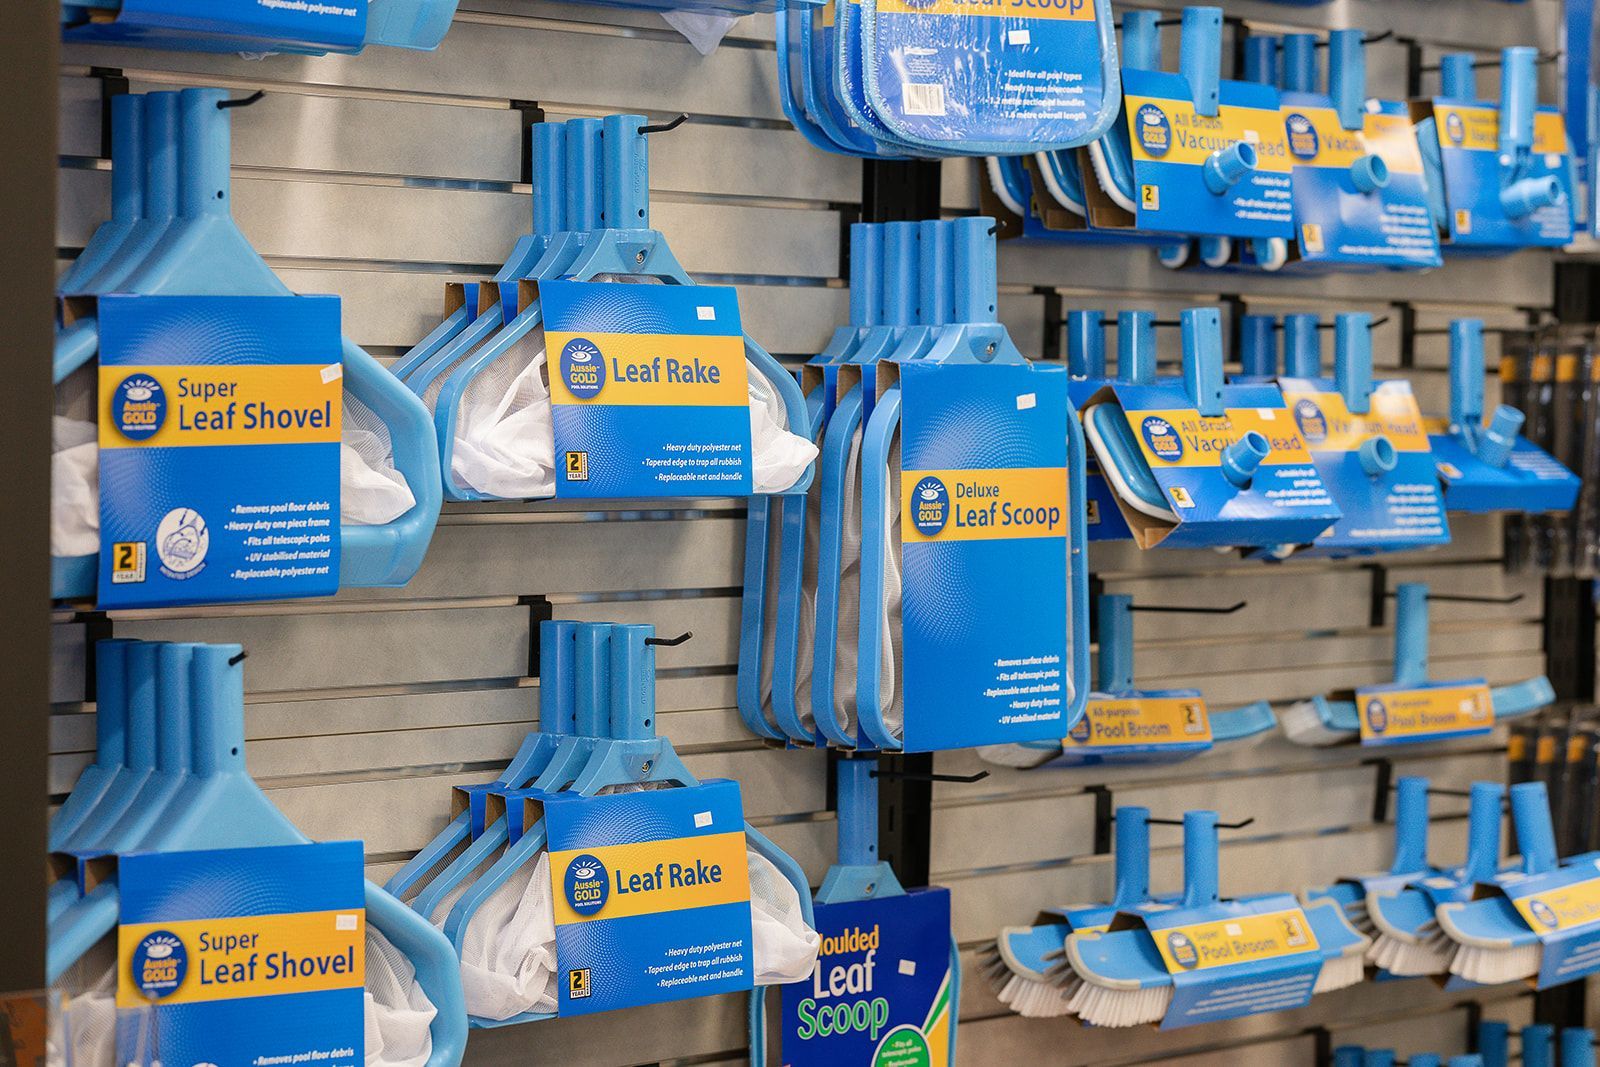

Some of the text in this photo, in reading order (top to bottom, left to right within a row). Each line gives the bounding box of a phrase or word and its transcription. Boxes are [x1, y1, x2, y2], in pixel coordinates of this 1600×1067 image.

[307, 3, 343, 14] polyester
[343, 8, 357, 16] net
[1011, 0, 1084, 15] oop
[1008, 70, 1026, 78] Ideal
[1027, 70, 1036, 79] for
[1037, 71, 1047, 79] all
[1063, 72, 1082, 82] types
[1004, 83, 1025, 93] Ready
[1037, 111, 1063, 119] overall
[1063, 112, 1087, 121] length
[1145, 187, 1152, 201] 2
[570, 363, 597, 373] Aussie
[612, 357, 720, 384] Leaf Rake
[570, 373, 598, 384] GOLD
[178, 378, 237, 401] Super
[122, 411, 157, 424] GOLD
[179, 401, 331, 430] Leaf Shovel
[666, 443, 687, 453] Heavy
[687, 443, 702, 453] duty
[702, 443, 731, 453] polyester
[570, 454, 579, 470] 2
[645, 458, 671, 468] Tapered
[672, 459, 687, 468] edge
[696, 460, 710, 468] trap
[710, 458, 718, 466] all
[719, 458, 742, 466] rubbish
[658, 473, 696, 483] Replaceable
[721, 472, 742, 480] handle
[956, 483, 1000, 498] Deluxe
[236, 501, 330, 515] Removes pool floor debris
[918, 510, 942, 521] GOLD
[955, 502, 1060, 530] Leaf Scoop
[229, 517, 330, 532] Heavy duty one piece frame
[248, 533, 330, 546] Fits all telescopic poles
[120, 546, 132, 568] 2
[249, 549, 331, 562] UV stabilised material
[235, 566, 329, 580] Replaceable polyester net
[1042, 654, 1059, 664] debris
[1000, 672, 1009, 681] Fits
[1010, 671, 1018, 680] all
[1029, 684, 1041, 693] and
[1041, 682, 1060, 692] handle
[1012, 697, 1060, 710] Heavy duty frame
[1037, 711, 1061, 720] material
[1095, 723, 1123, 737] Pool
[1128, 722, 1170, 737] Broom
[615, 859, 722, 895] Leaf Rake
[574, 880, 600, 890] Aussie
[574, 889, 601, 901] GOLD
[199, 931, 258, 955] Super
[668, 940, 743, 957] Heavy duty polyester net
[200, 946, 354, 985] Leaf Shovel
[648, 963, 673, 975] Tapered
[674, 961, 689, 971] edge
[697, 960, 711, 968] trap
[711, 957, 719, 965] all
[719, 953, 743, 964] rubbish
[143, 967, 177, 982] GOLD
[573, 971, 582, 988] 2
[660, 975, 698, 988] Replaceable
[709, 971, 721, 979] and
[722, 968, 743, 978] handle
[814, 949, 876, 999] Leaf
[797, 997, 889, 1041] Scoop
[258, 1048, 354, 1066] Removes pool floor debris
